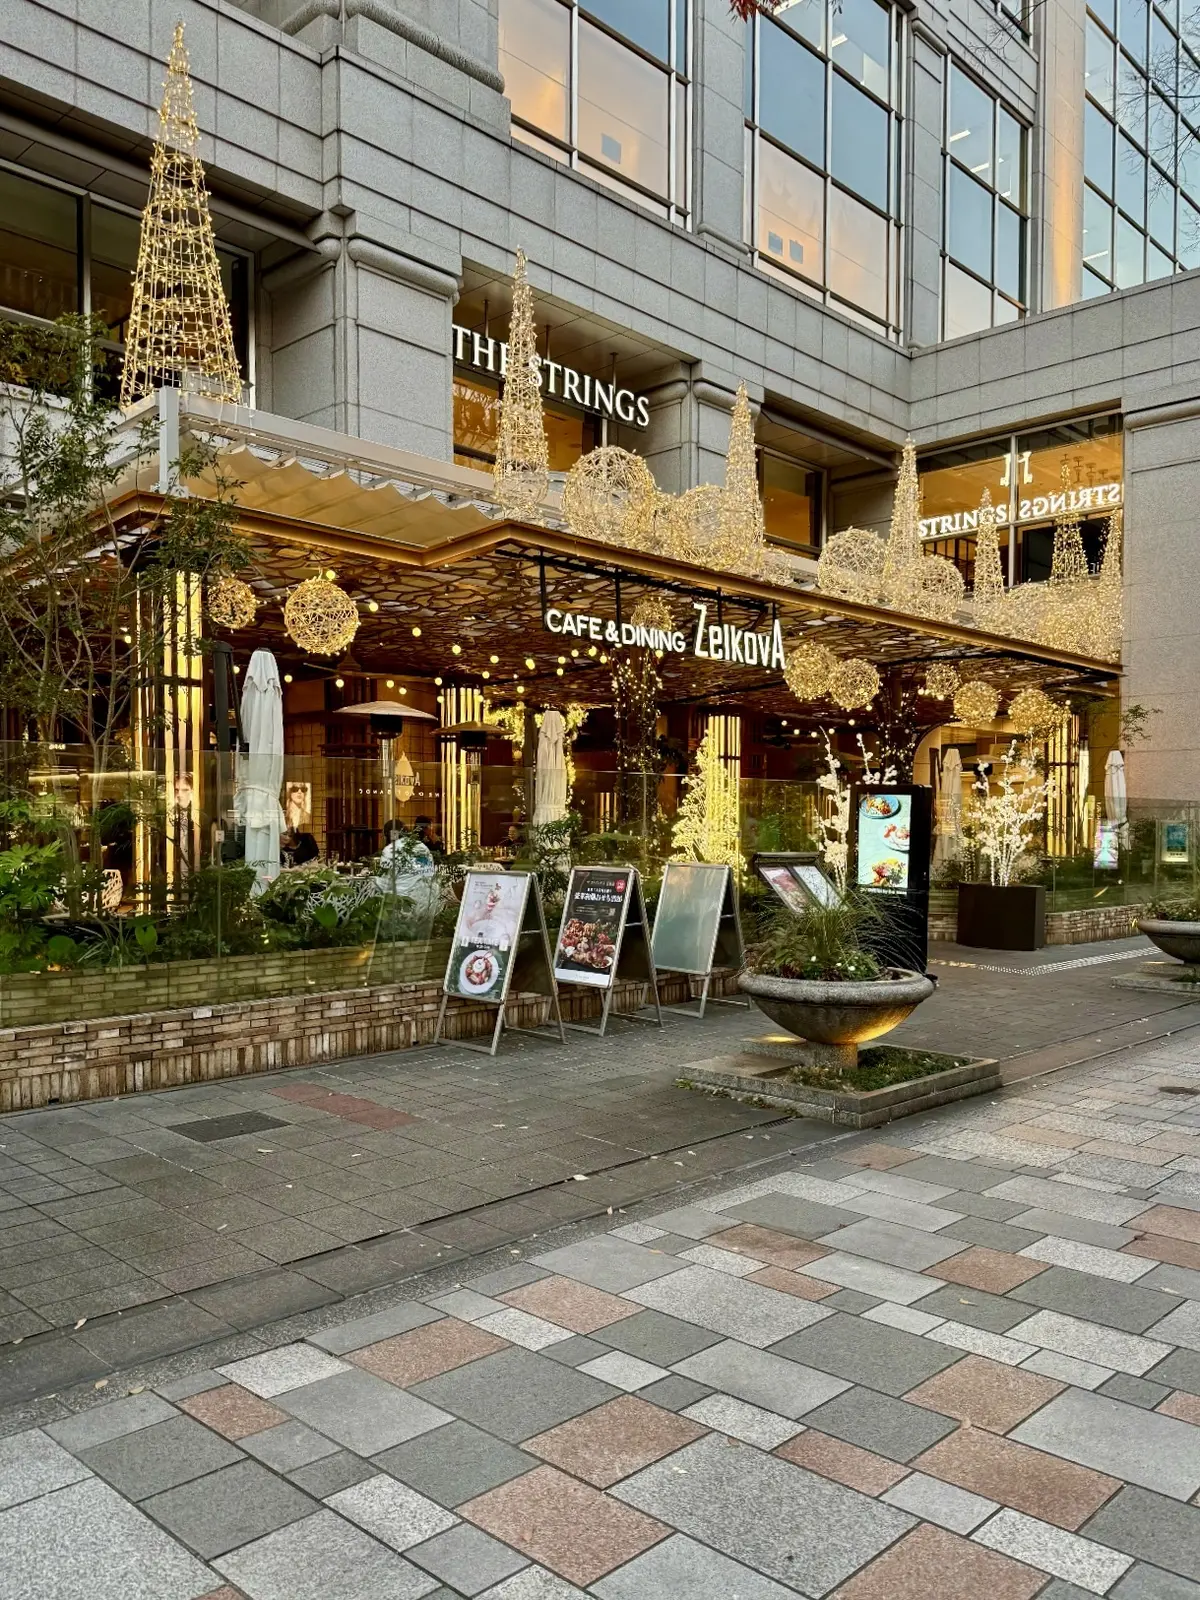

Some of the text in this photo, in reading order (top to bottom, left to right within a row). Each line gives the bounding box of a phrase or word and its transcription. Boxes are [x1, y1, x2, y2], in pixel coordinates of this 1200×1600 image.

[528, 353, 650, 427] STRINGS
[918, 503, 1007, 538] STRINGS
[546, 608, 603, 640] CAFE
[604, 620, 620, 643] &
[621, 622, 687, 653] DINING
